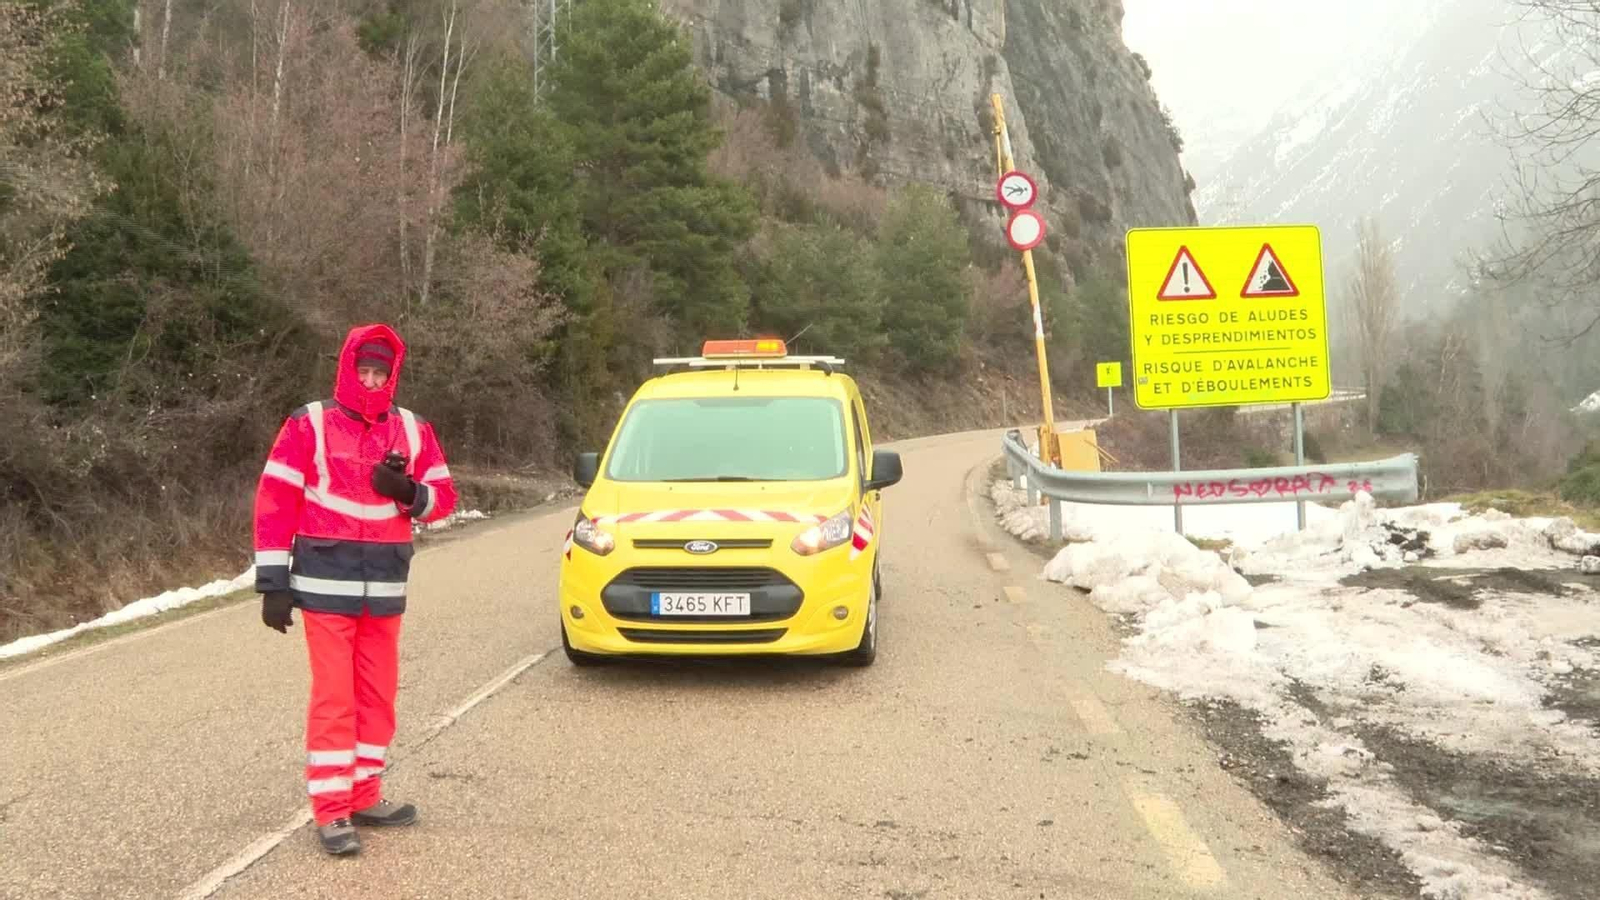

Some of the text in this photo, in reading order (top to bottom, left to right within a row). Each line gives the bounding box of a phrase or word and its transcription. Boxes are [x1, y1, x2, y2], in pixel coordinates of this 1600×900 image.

[1150, 309, 1308, 325] RIESGO DE ALUDES
[1144, 328, 1317, 346] Y DESPRENDIMIENTOS
[1143, 356, 1318, 374] RISQUE D'AVALANCHE
[1153, 375, 1313, 394] ET D'ÉBOULEMENTS
[690, 541, 710, 553] Ford
[664, 596, 707, 612] 3465
[713, 596, 745, 612] KFT
